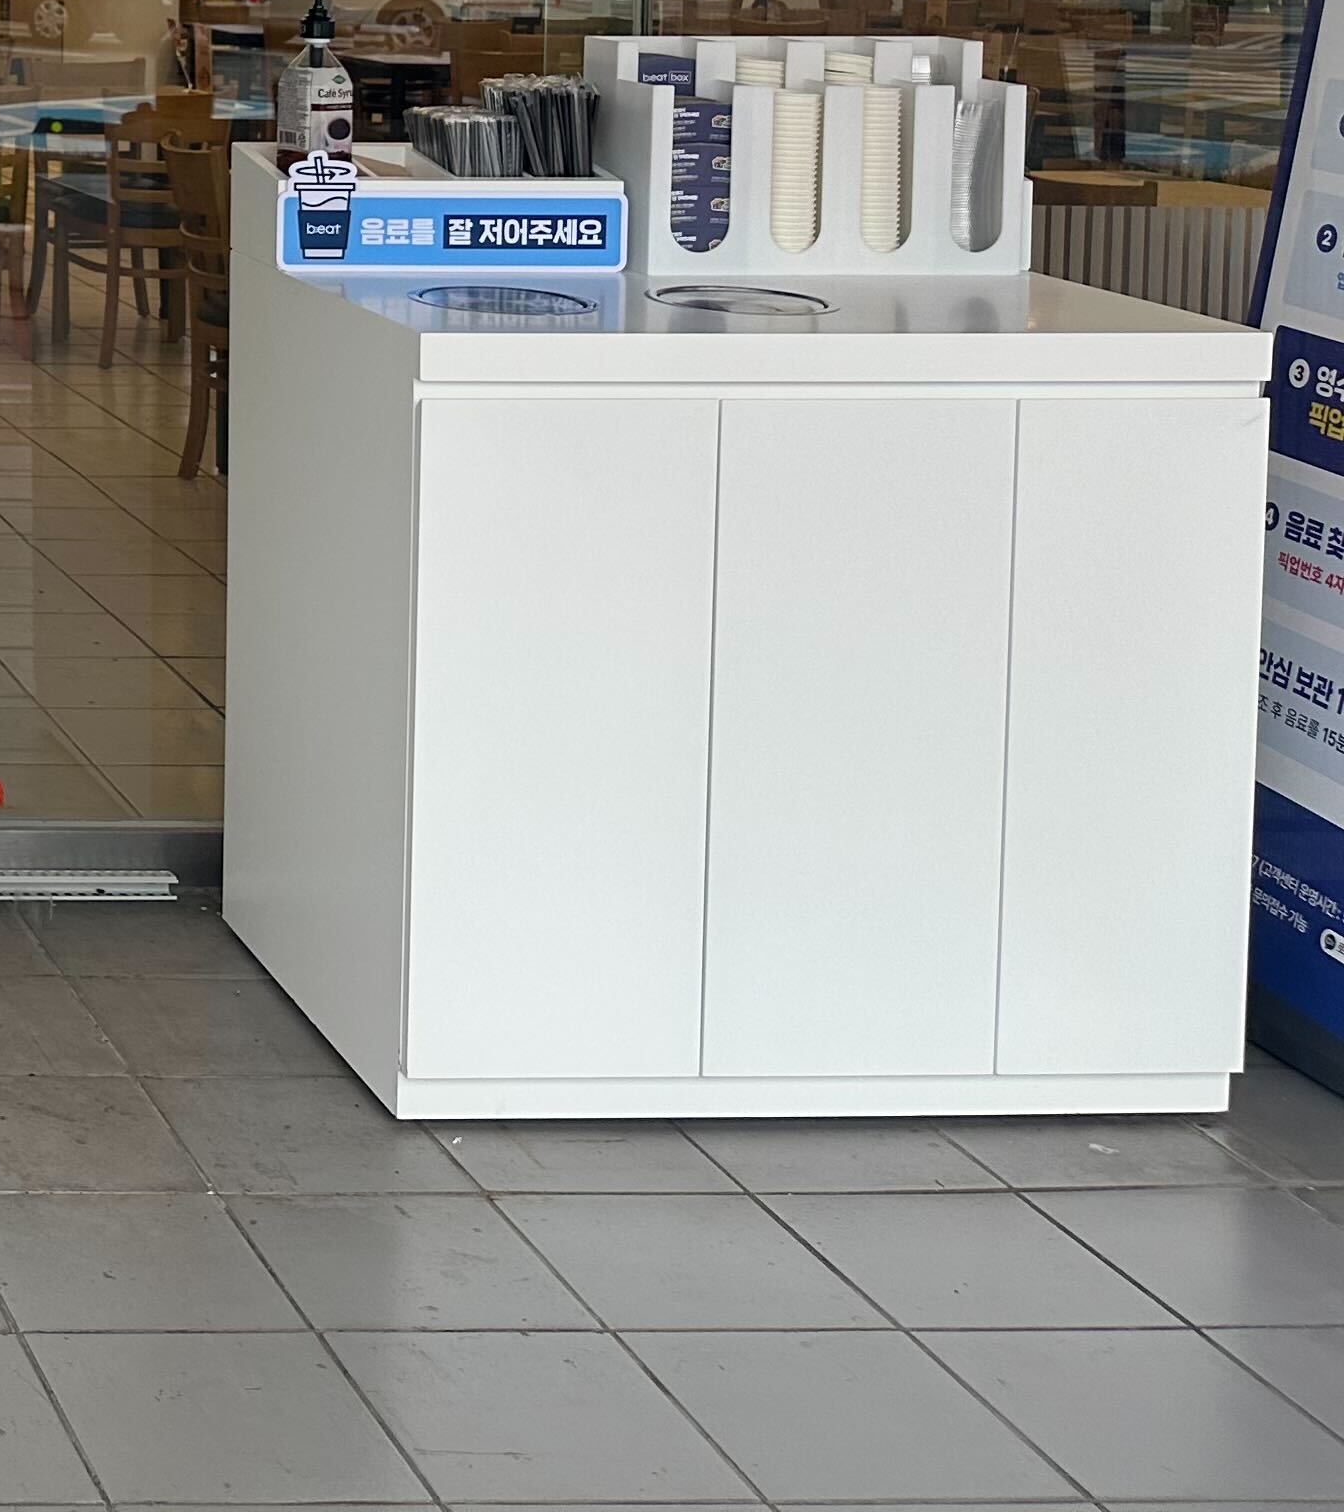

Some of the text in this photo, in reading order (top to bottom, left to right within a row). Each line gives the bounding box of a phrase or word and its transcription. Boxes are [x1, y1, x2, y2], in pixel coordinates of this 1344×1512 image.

[360, 218, 603, 246] 음료를 잘 저어주세요
[1284, 511, 1325, 551] 음료
[1277, 551, 1324, 585] 픽업번호
[1292, 666, 1334, 710] 보관
[1270, 701, 1321, 740] 후 음료를
